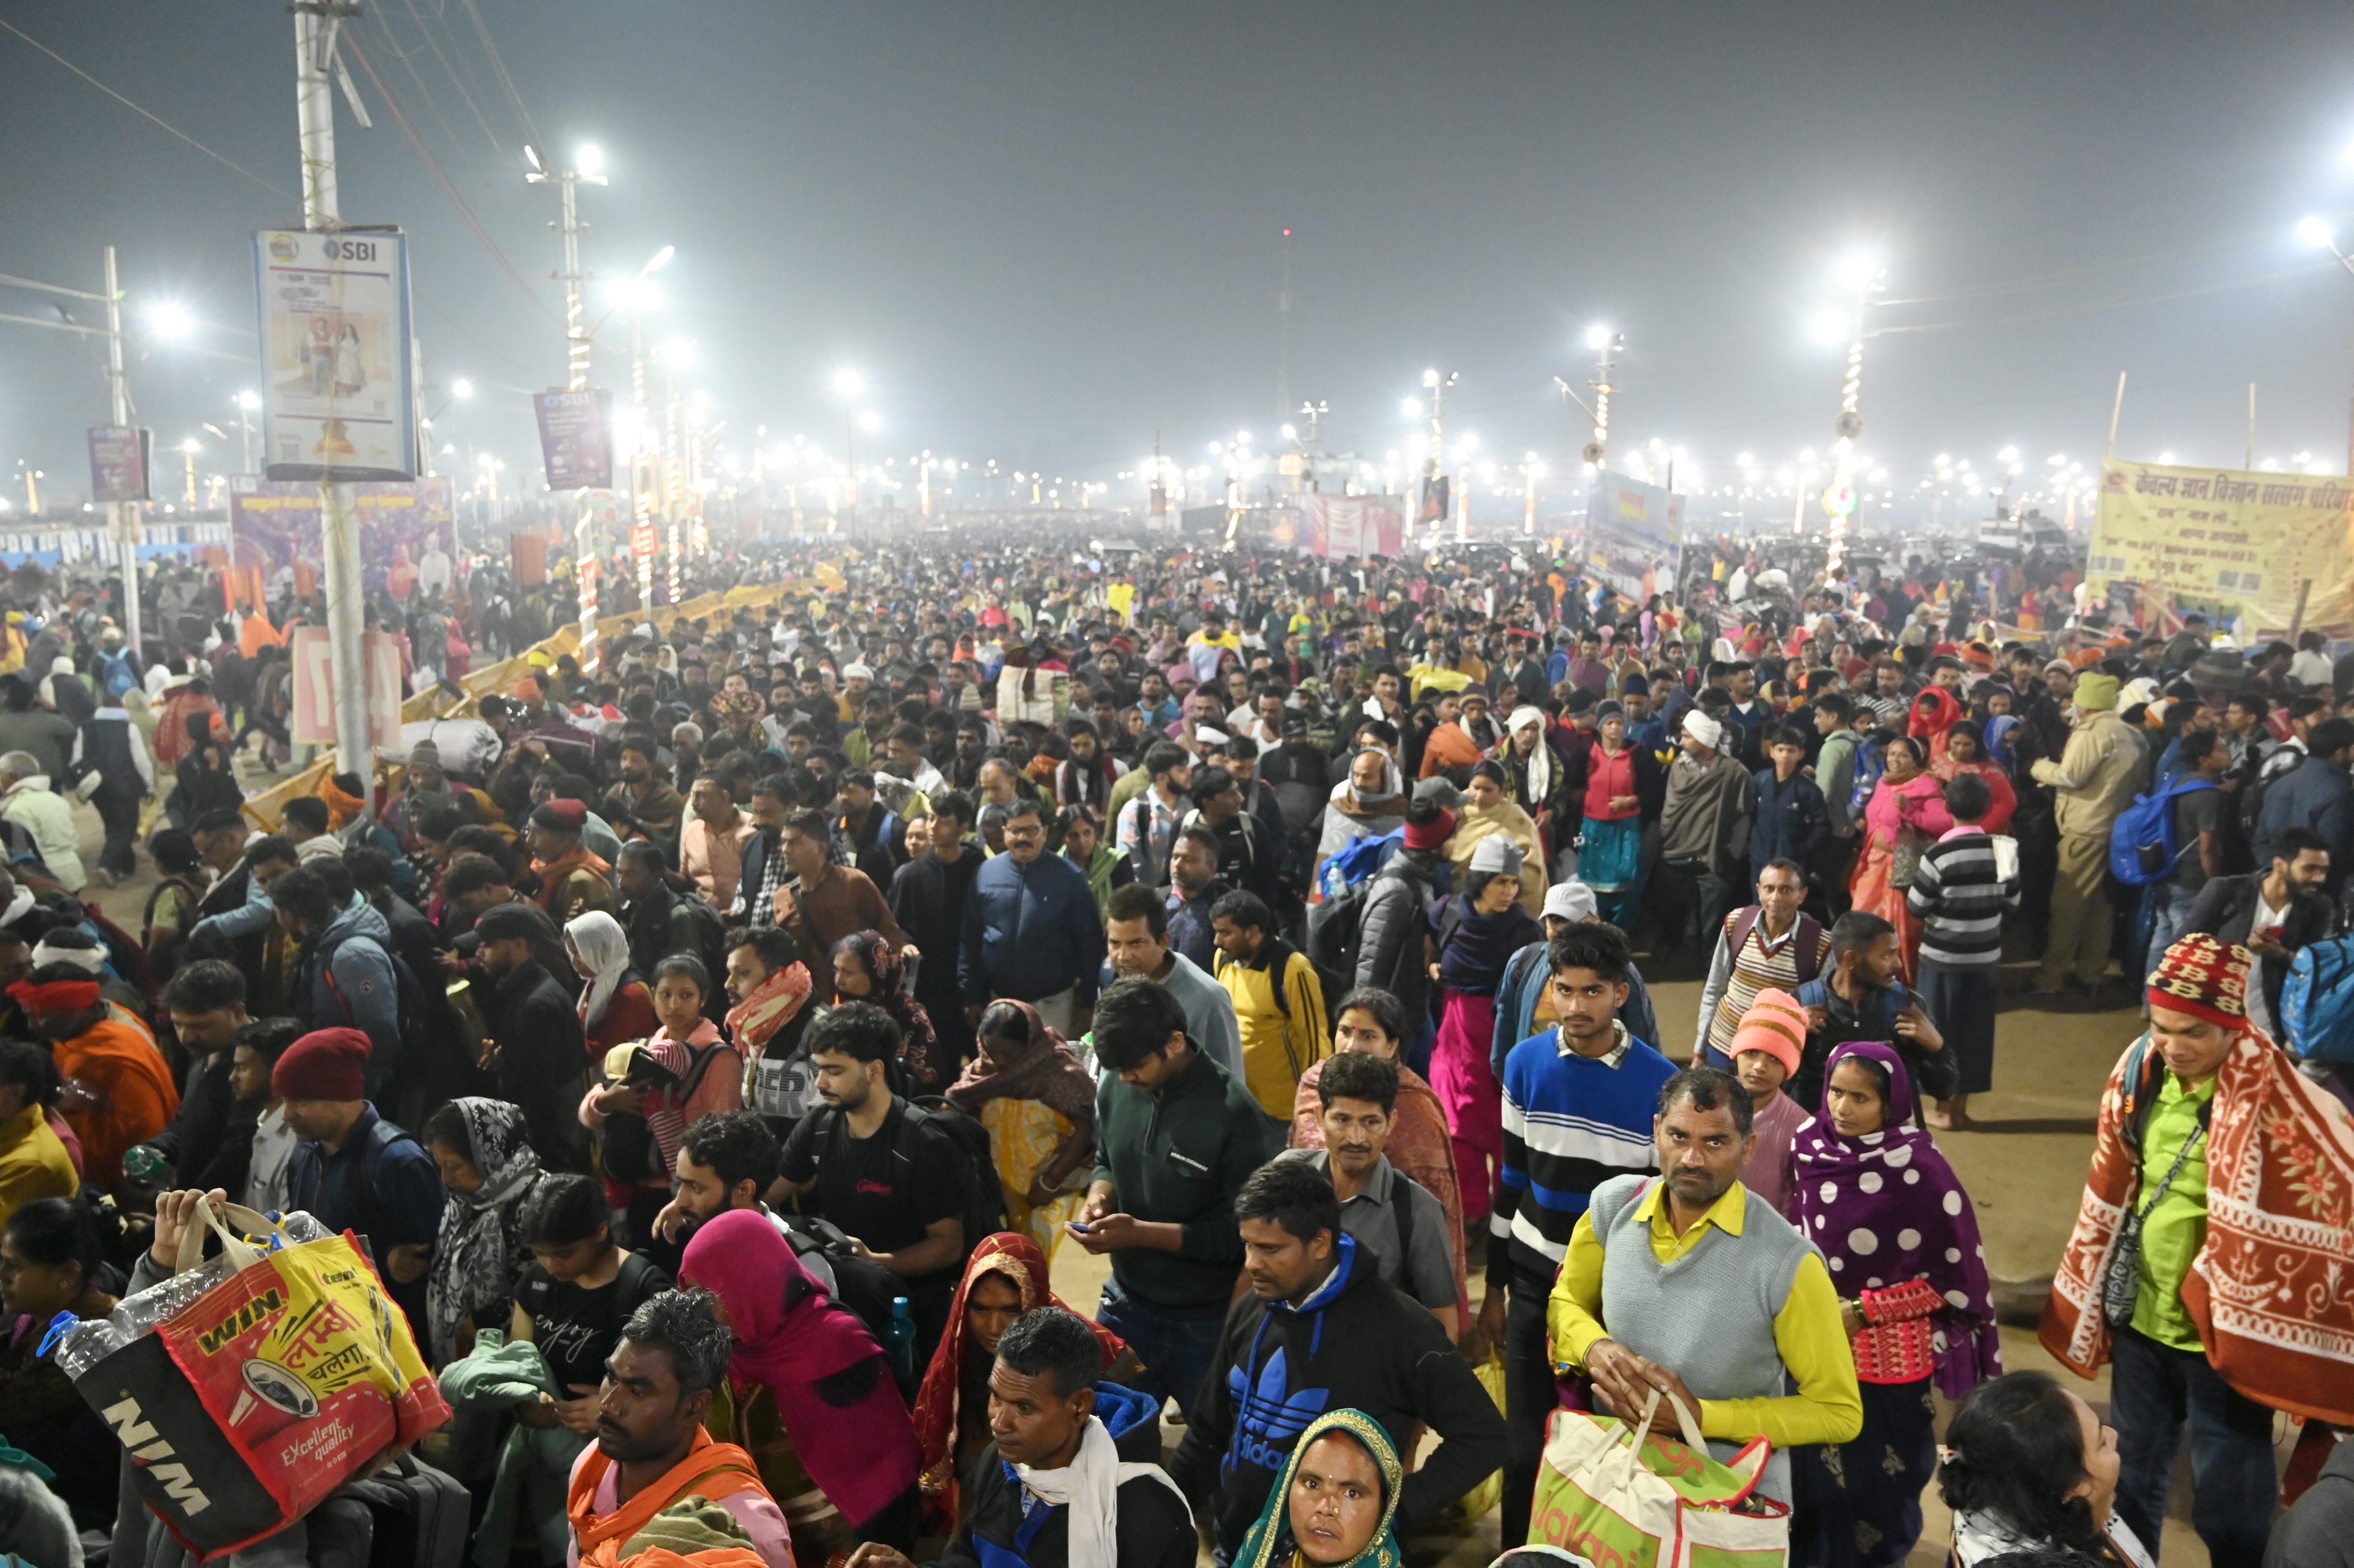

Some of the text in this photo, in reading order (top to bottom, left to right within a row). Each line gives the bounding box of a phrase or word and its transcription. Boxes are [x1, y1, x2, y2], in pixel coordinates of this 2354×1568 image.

[342, 241, 376, 261] SBI
[561, 392, 590, 407] SBI
[198, 1288, 281, 1356] WIN
[536, 1314, 602, 1363] enjoy
[102, 1397, 211, 1517] WIN
[315, 1423, 354, 1461] quality
